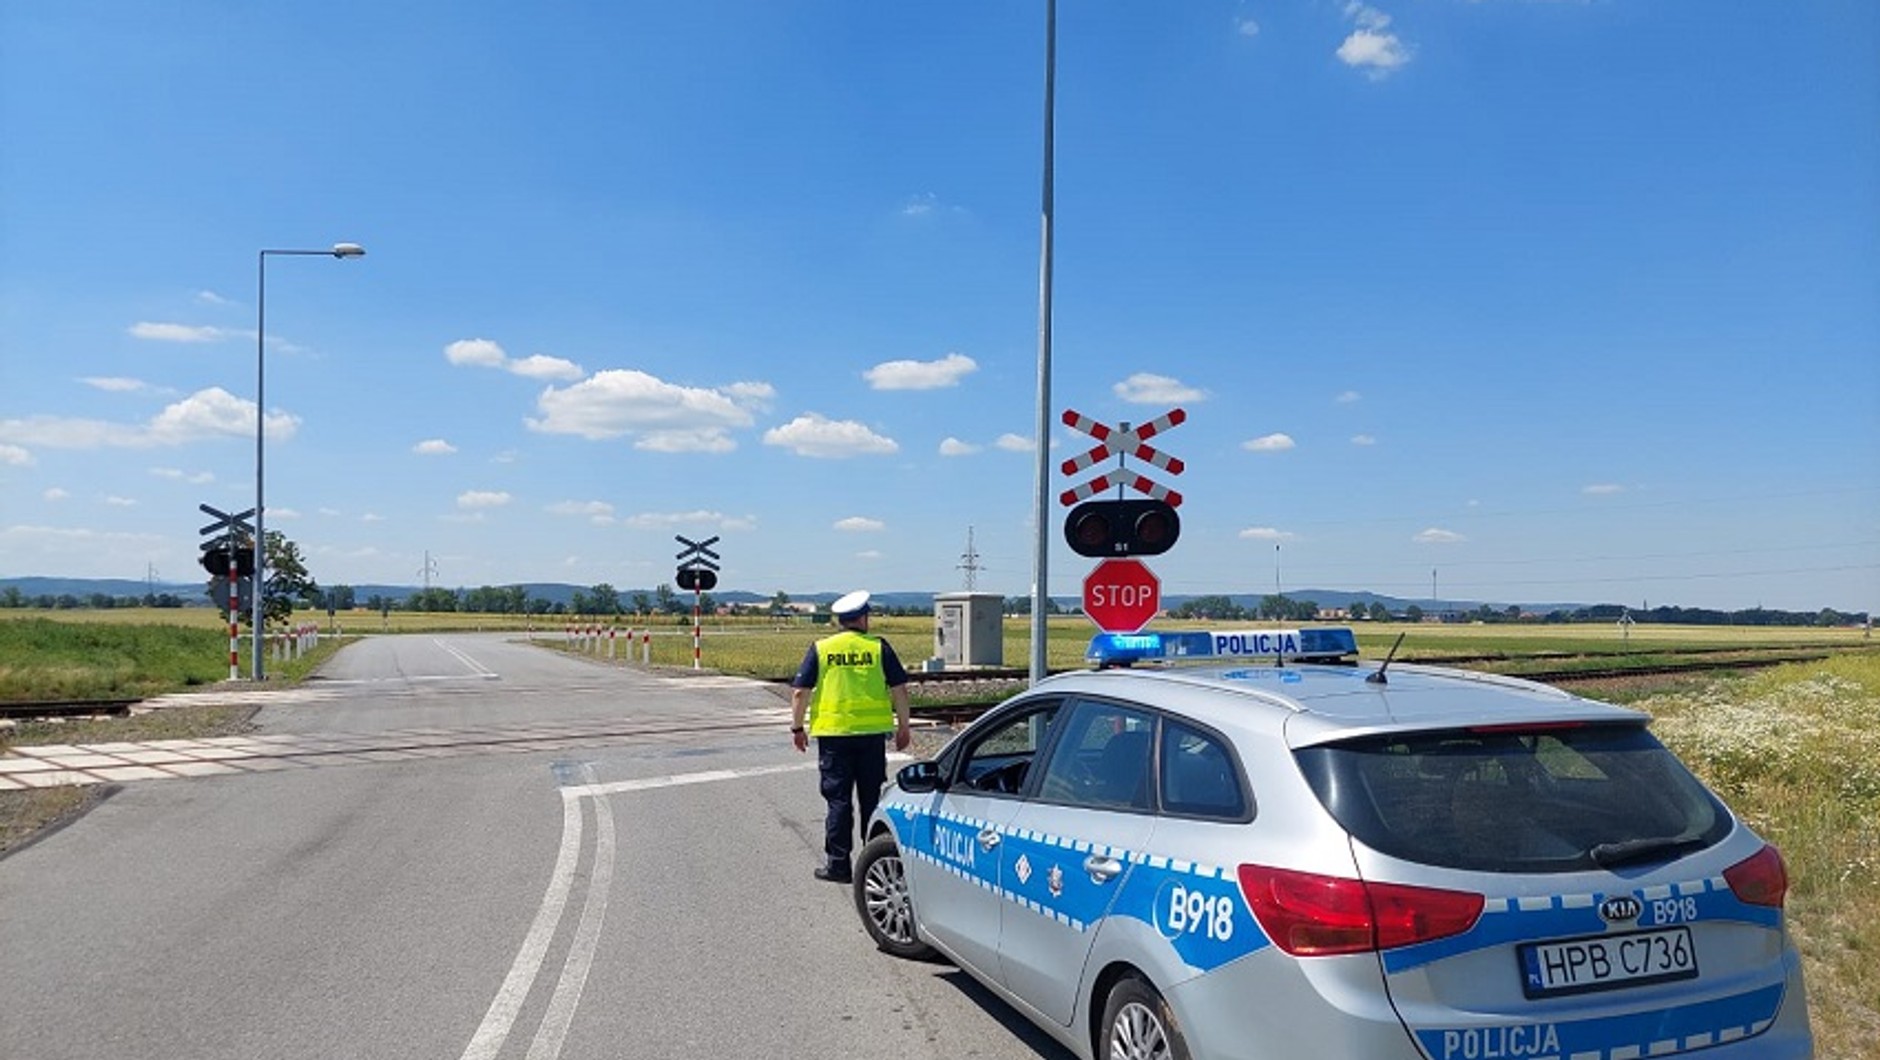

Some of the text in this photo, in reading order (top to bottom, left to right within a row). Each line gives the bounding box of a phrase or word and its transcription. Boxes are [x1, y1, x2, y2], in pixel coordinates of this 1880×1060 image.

[1092, 585, 1152, 607] STOP
[1217, 634, 1297, 654] POLICJA
[827, 652, 873, 666] POLICJA
[934, 824, 975, 868] POLICJA
[1169, 886, 1234, 941] B918
[1606, 901, 1637, 918] KIA
[1654, 898, 1697, 924] B918
[1544, 934, 1688, 984] HPB C736
[1444, 1025, 1561, 1060] POLICJA
